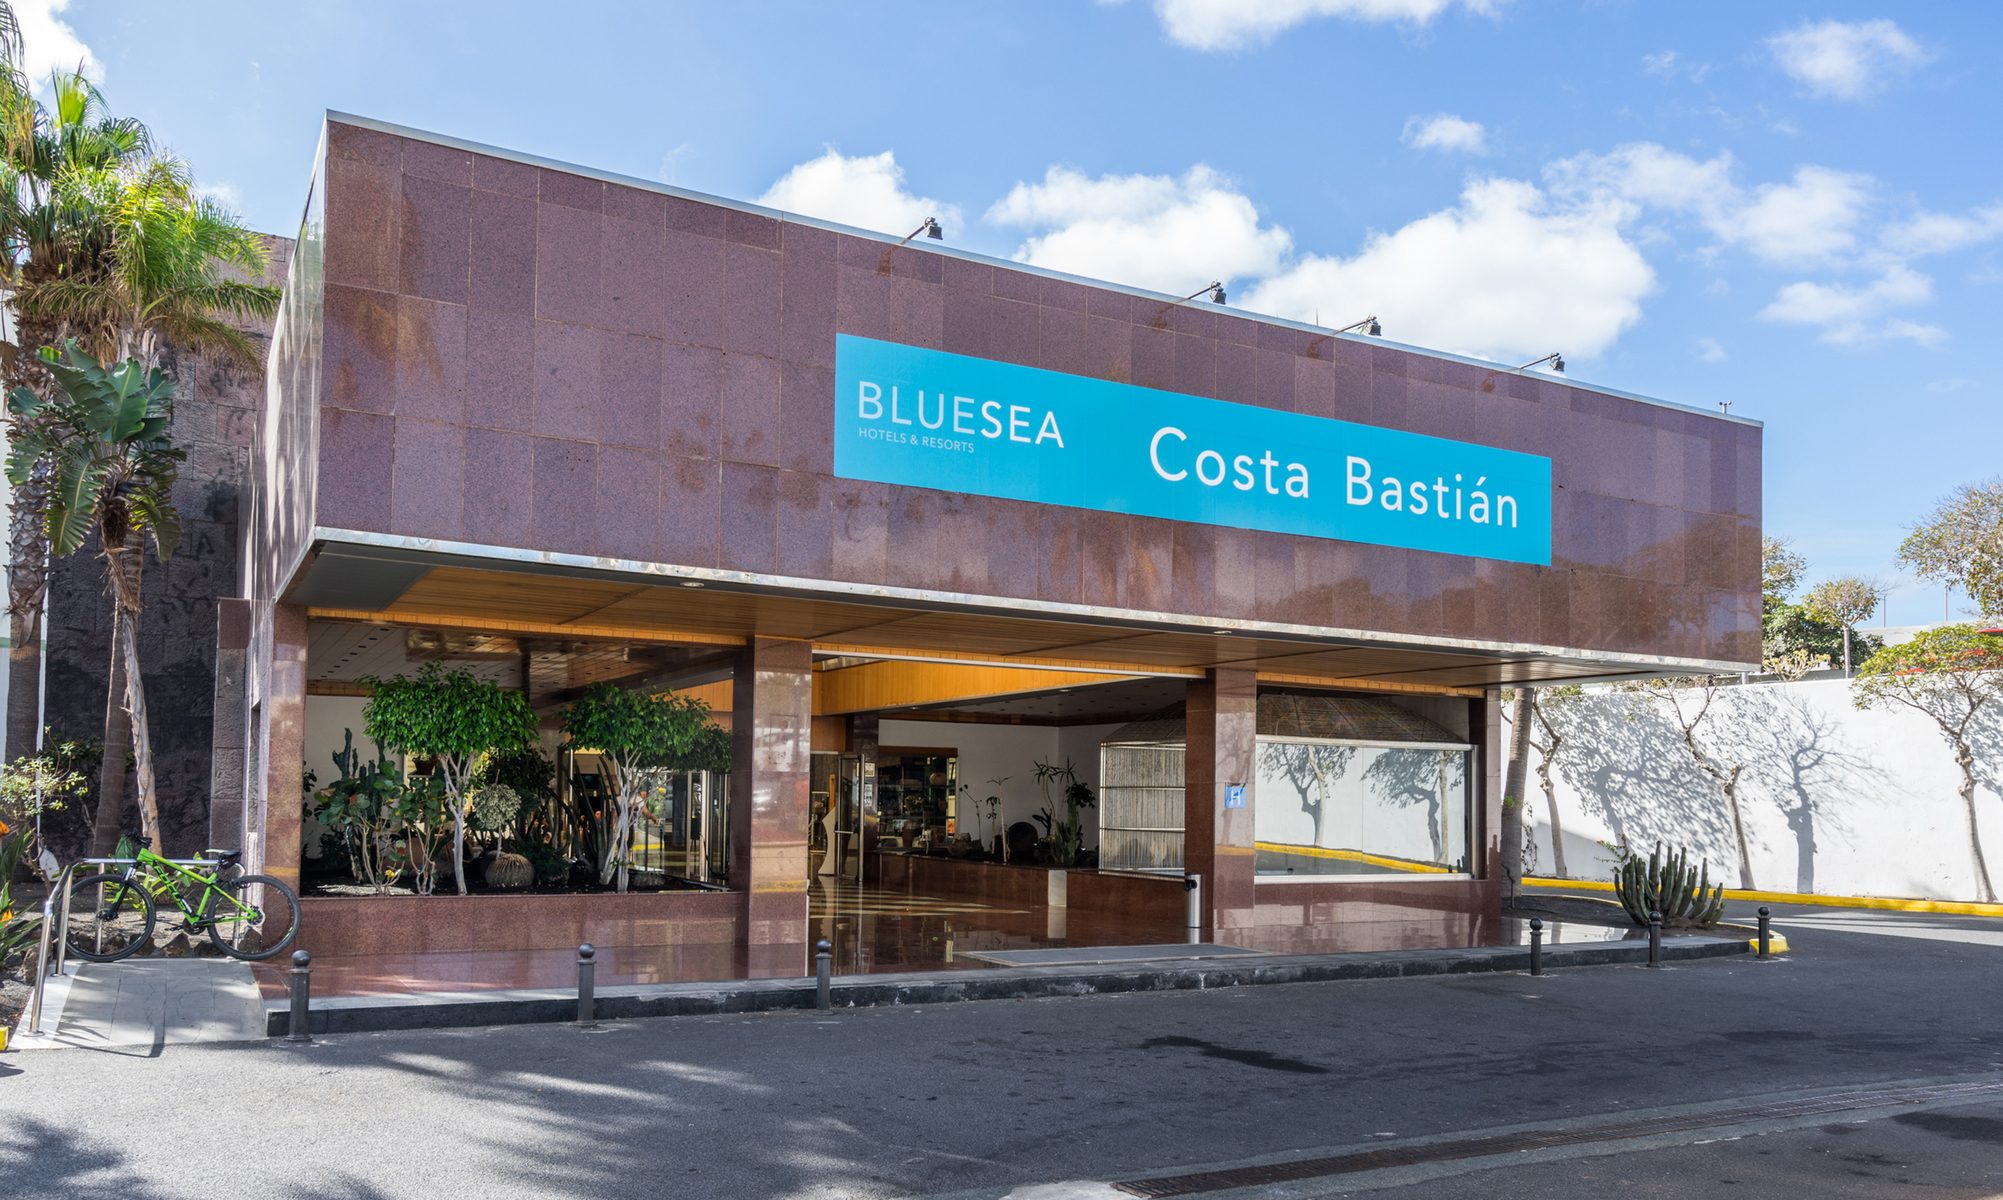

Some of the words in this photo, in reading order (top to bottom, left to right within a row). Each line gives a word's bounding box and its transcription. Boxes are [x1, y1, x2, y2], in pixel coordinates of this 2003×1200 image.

[858, 380, 1065, 449] BLUESEA
[858, 427, 907, 444] HOTELS
[910, 434, 919, 446] &
[922, 436, 975, 454] RESORTS
[1149, 426, 1309, 499] Costa
[1346, 455, 1518, 528] Bastián
[1230, 789, 1241, 806] H
[153, 865, 187, 911] FOCUS
